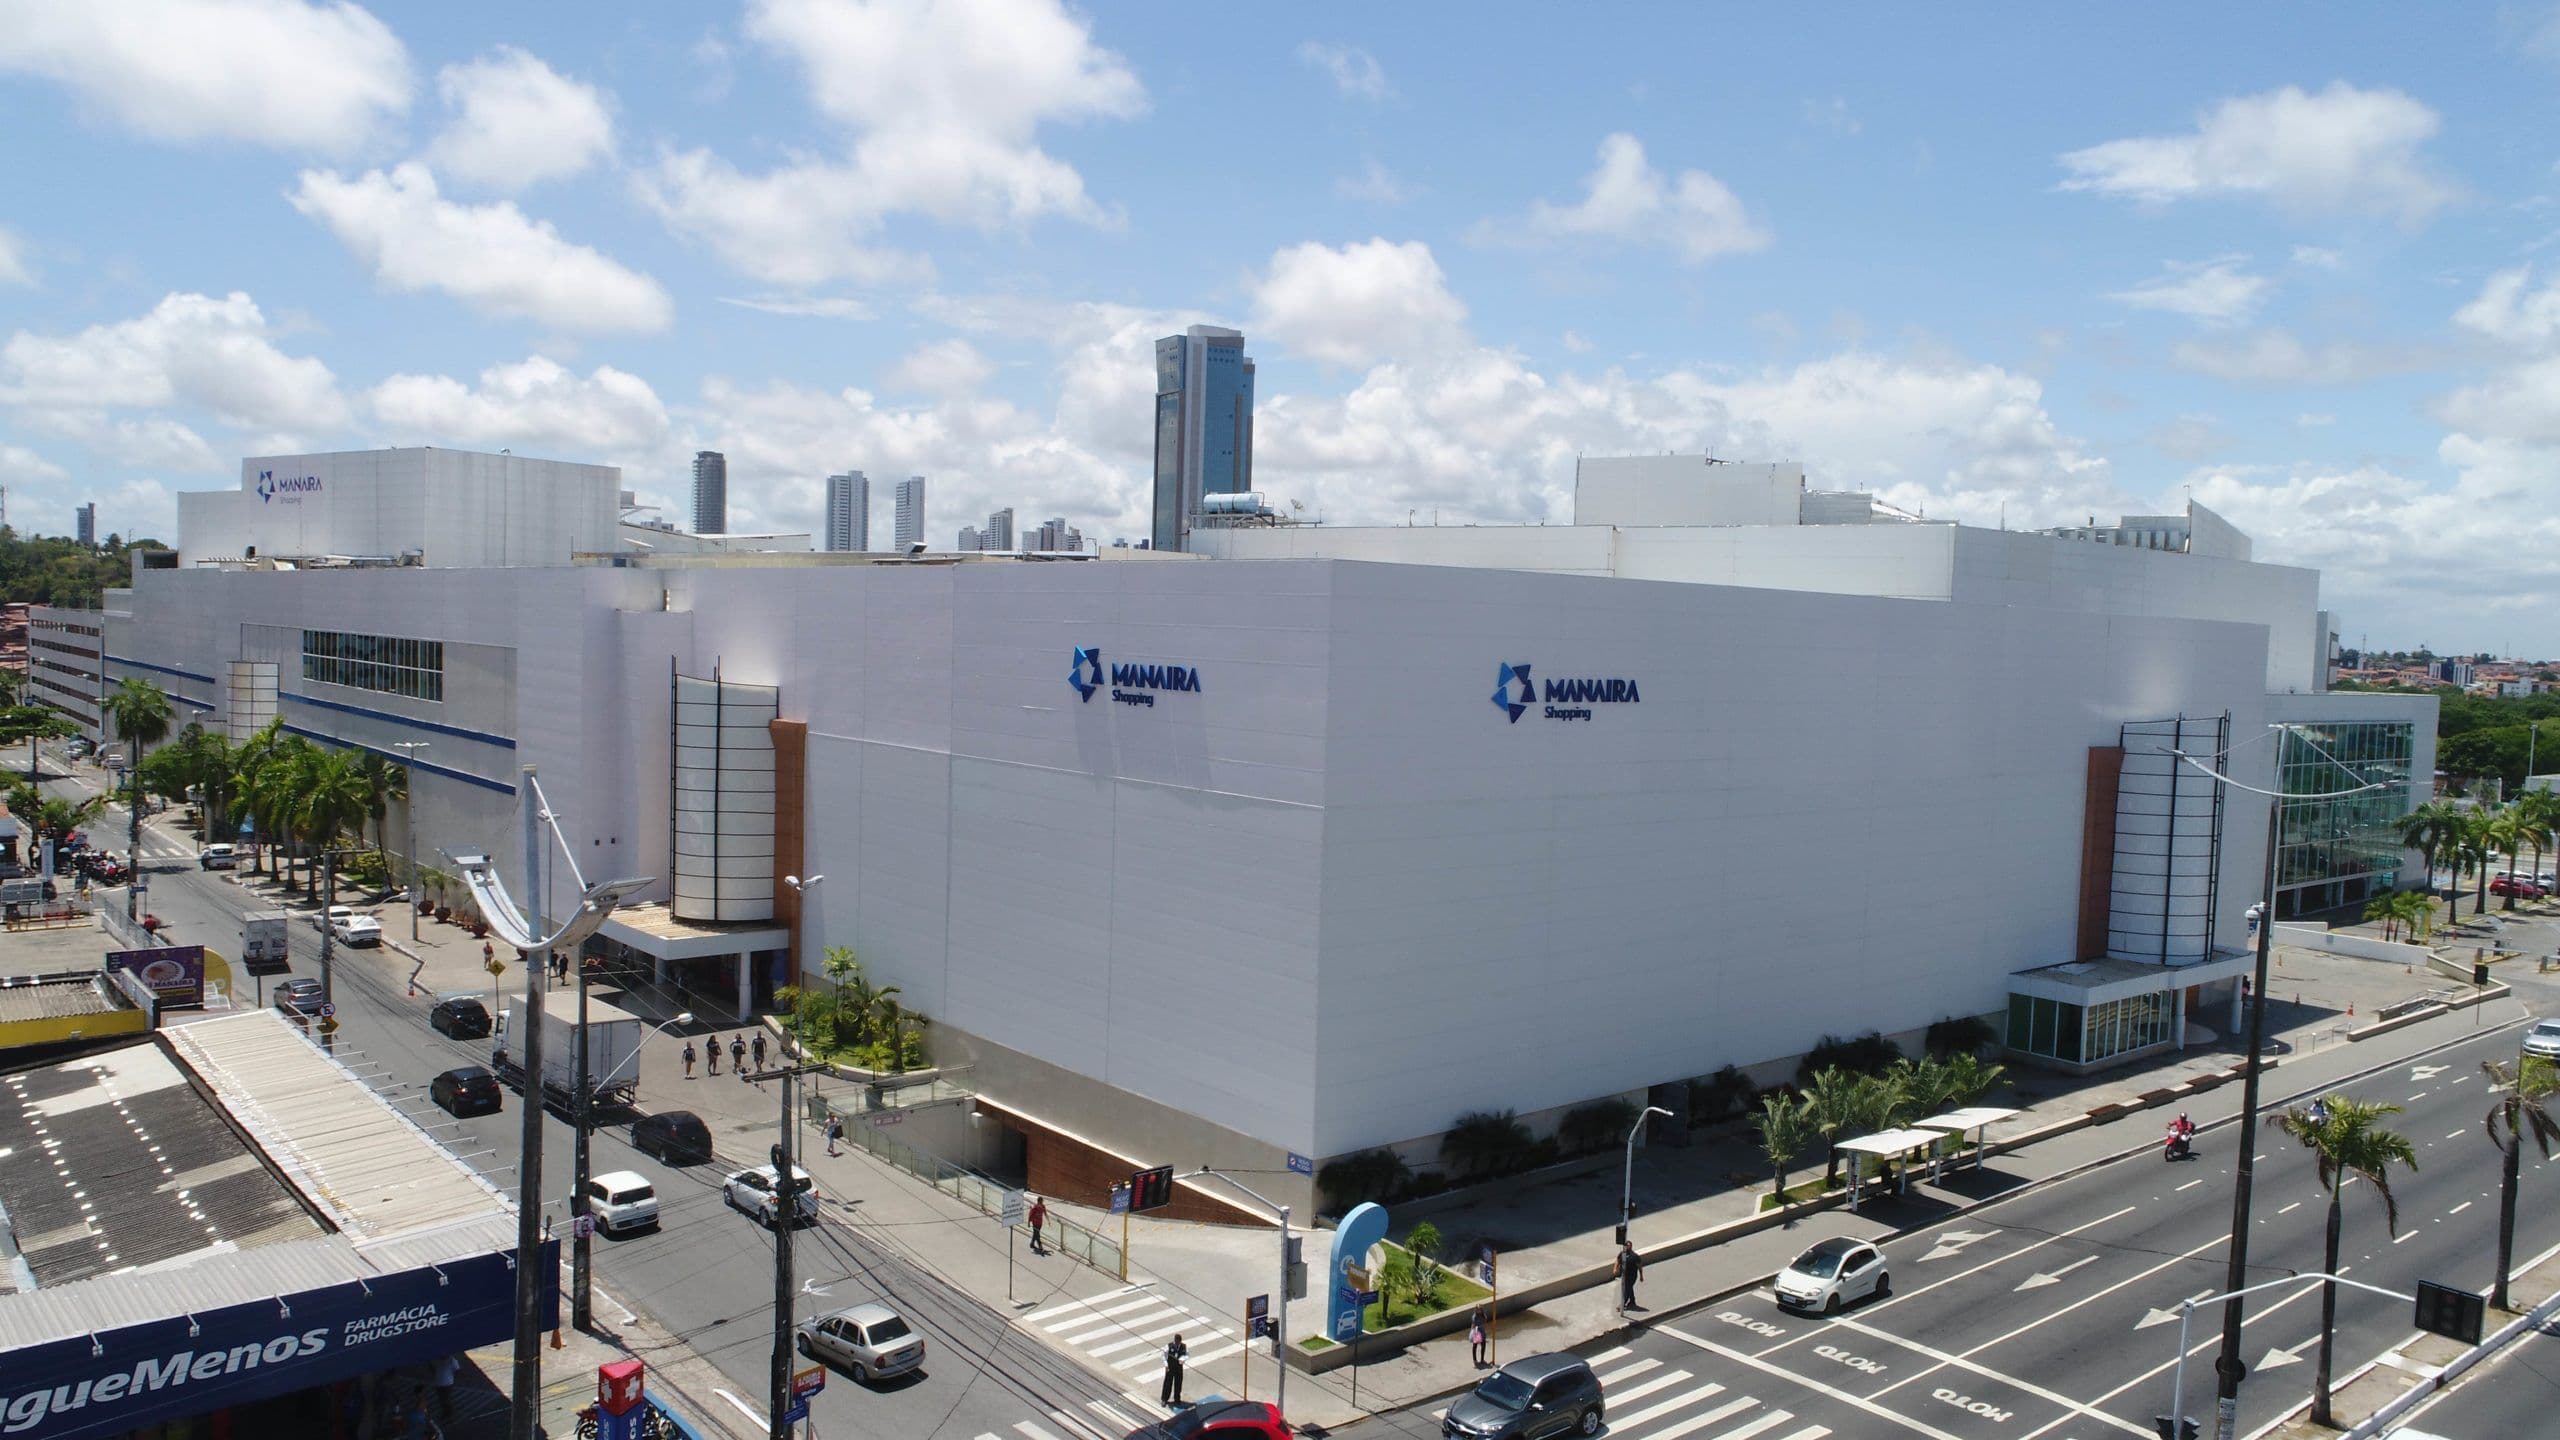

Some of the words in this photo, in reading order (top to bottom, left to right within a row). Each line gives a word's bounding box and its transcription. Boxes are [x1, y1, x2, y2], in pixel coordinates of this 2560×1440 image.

[1111, 689, 1154, 707] Shopping
[1544, 706, 1591, 721] Shopping
[344, 1303, 436, 1334] FARMÁCIA
[344, 1312, 450, 1347] DRUGSTORE
[1714, 1311, 1786, 1338] MOTO
[1812, 1345, 1888, 1375] MOTO
[0, 1327, 330, 1433] gueMenos
[1931, 1387, 2014, 1423] MOTO
